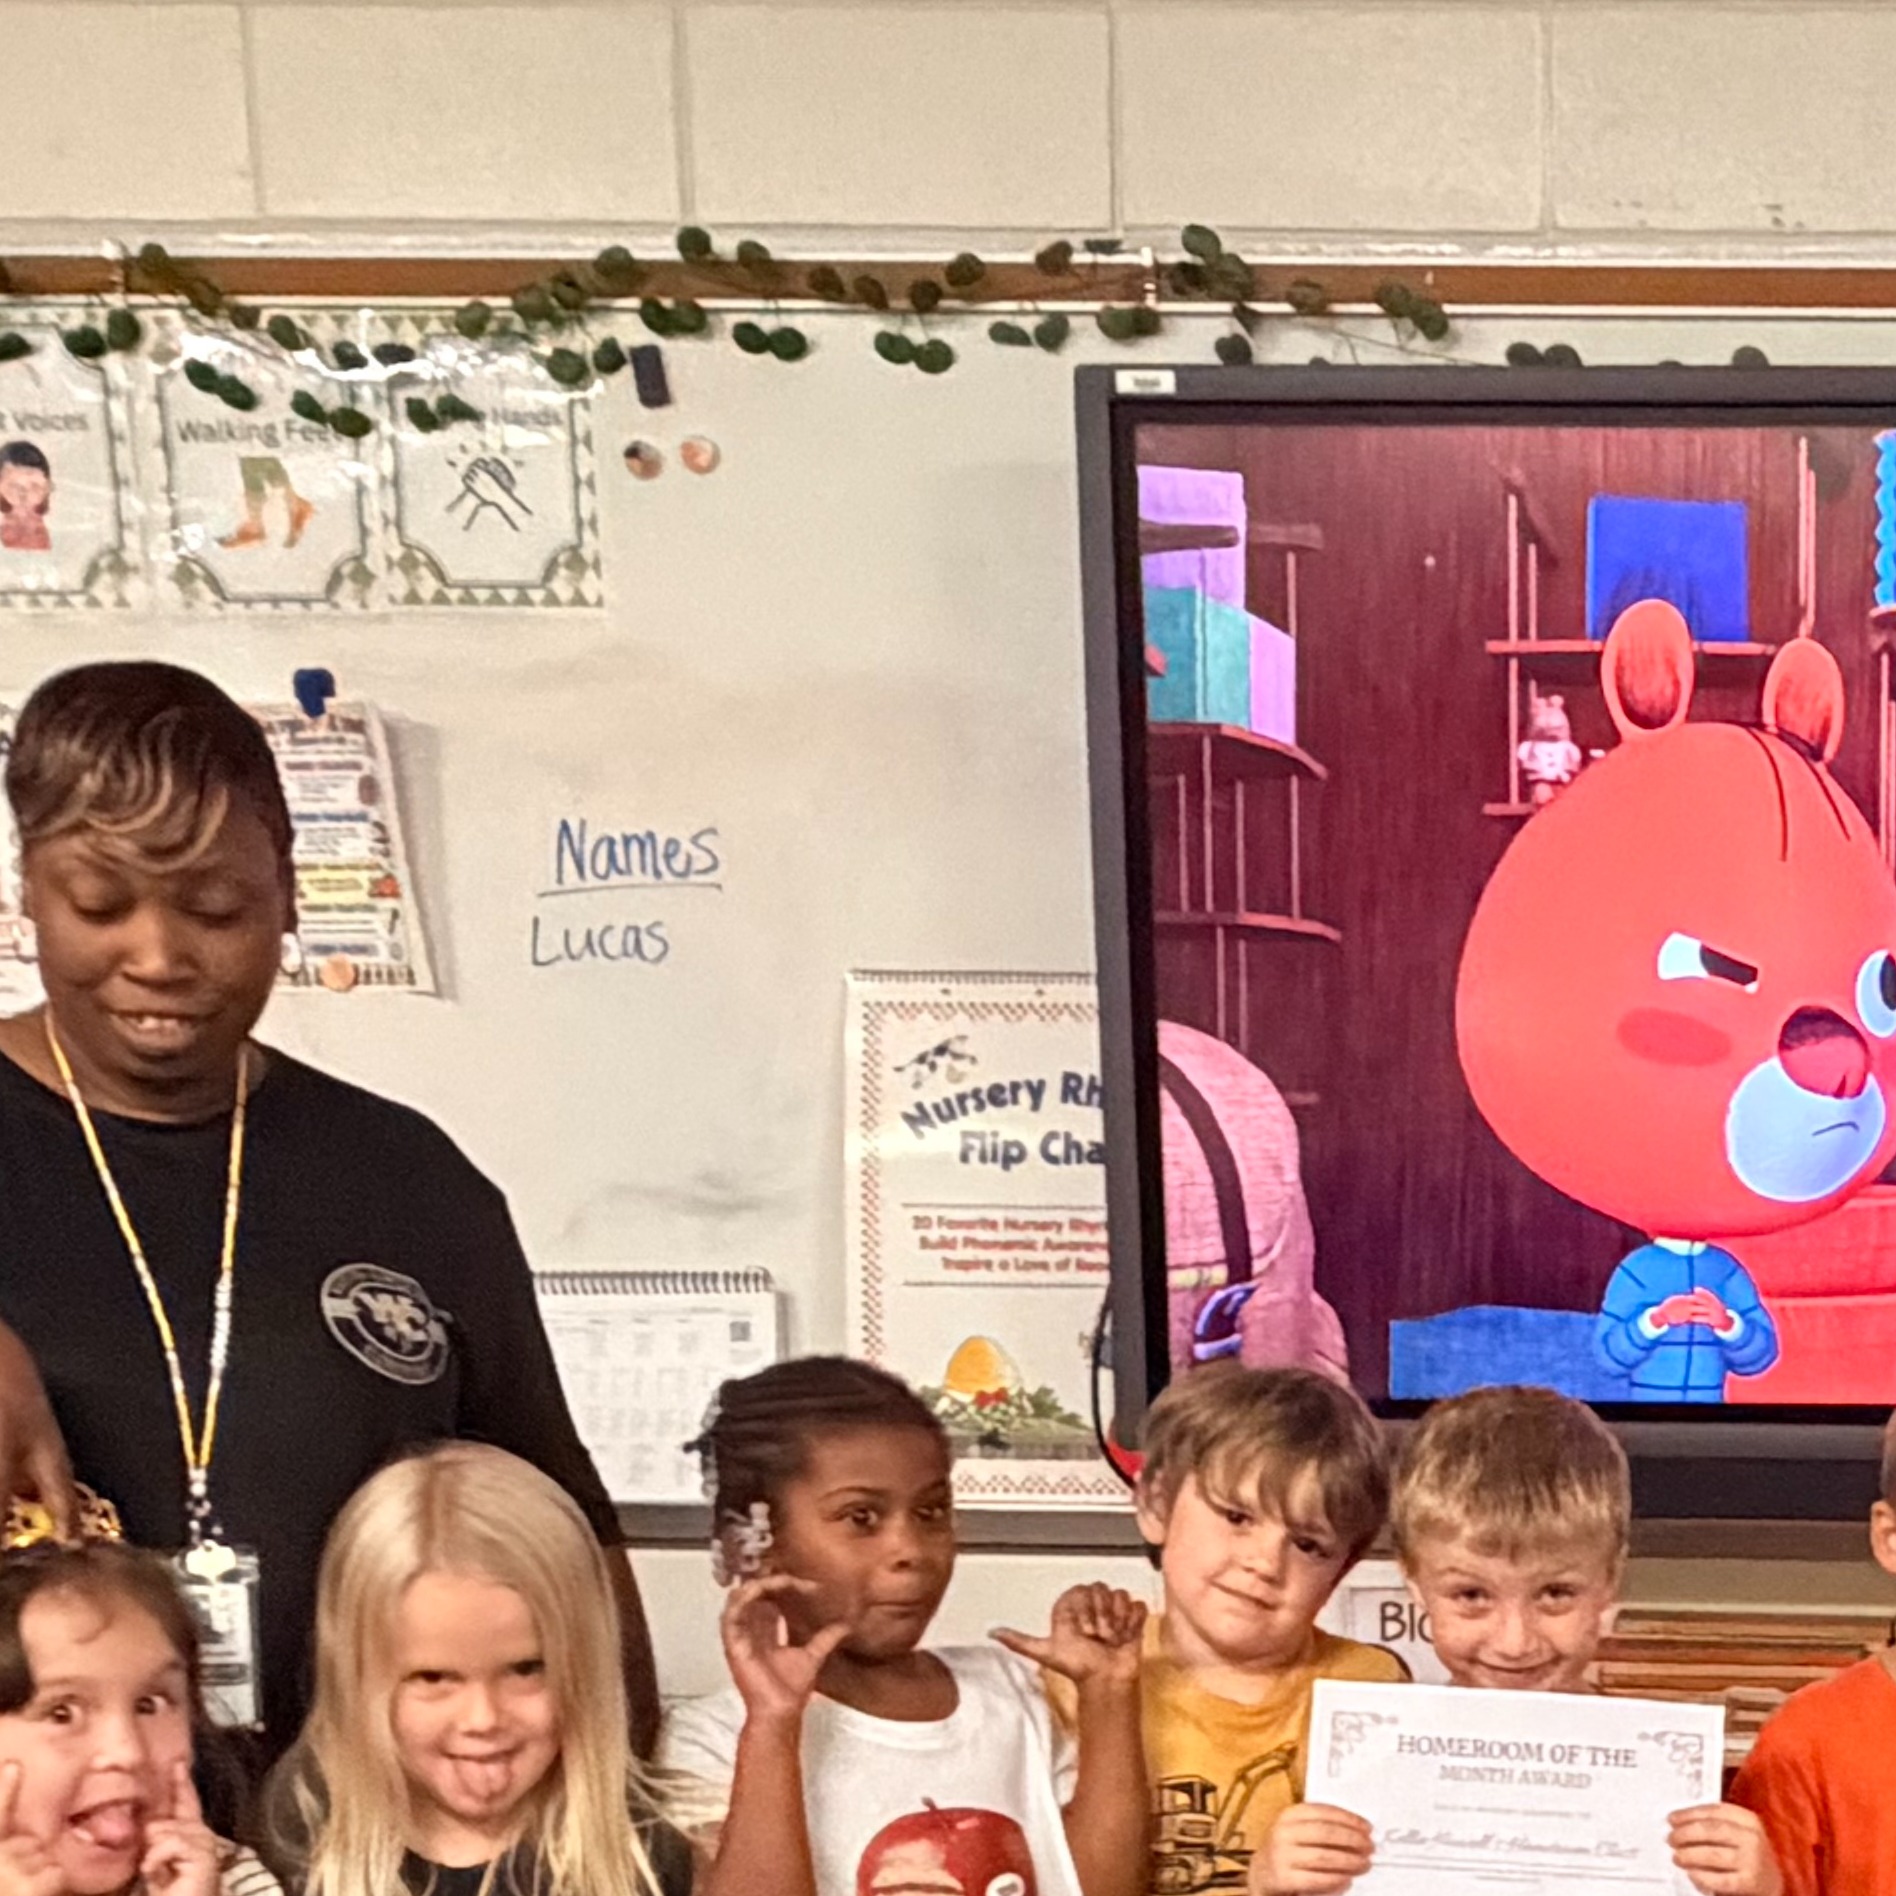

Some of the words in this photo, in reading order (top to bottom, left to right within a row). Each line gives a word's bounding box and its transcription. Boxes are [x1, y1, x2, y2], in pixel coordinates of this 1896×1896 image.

[177, 418, 280, 449] Walking
[285, 418, 345, 445] Fee
[556, 818, 720, 886] Names
[532, 915, 670, 967] Lucas
[900, 1078, 1047, 1140] Nursery
[959, 1130, 1028, 1172] Flip
[936, 1215, 999, 1232] Favorite
[1003, 1216, 1064, 1235] Nursery
[919, 1236, 958, 1251] Build
[962, 1236, 1038, 1252] Phonemic
[941, 1256, 994, 1273] Inspire
[997, 1259, 1010, 1272] a
[1013, 1257, 1051, 1272] Love
[1054, 1257, 1071, 1272] of
[1396, 1733, 1545, 1763] HOMEROOM
[1549, 1744, 1582, 1765] OF
[1586, 1745, 1638, 1769] THE
[1438, 1764, 1515, 1786] MONTH
[1517, 1769, 1593, 1790] AWARD
